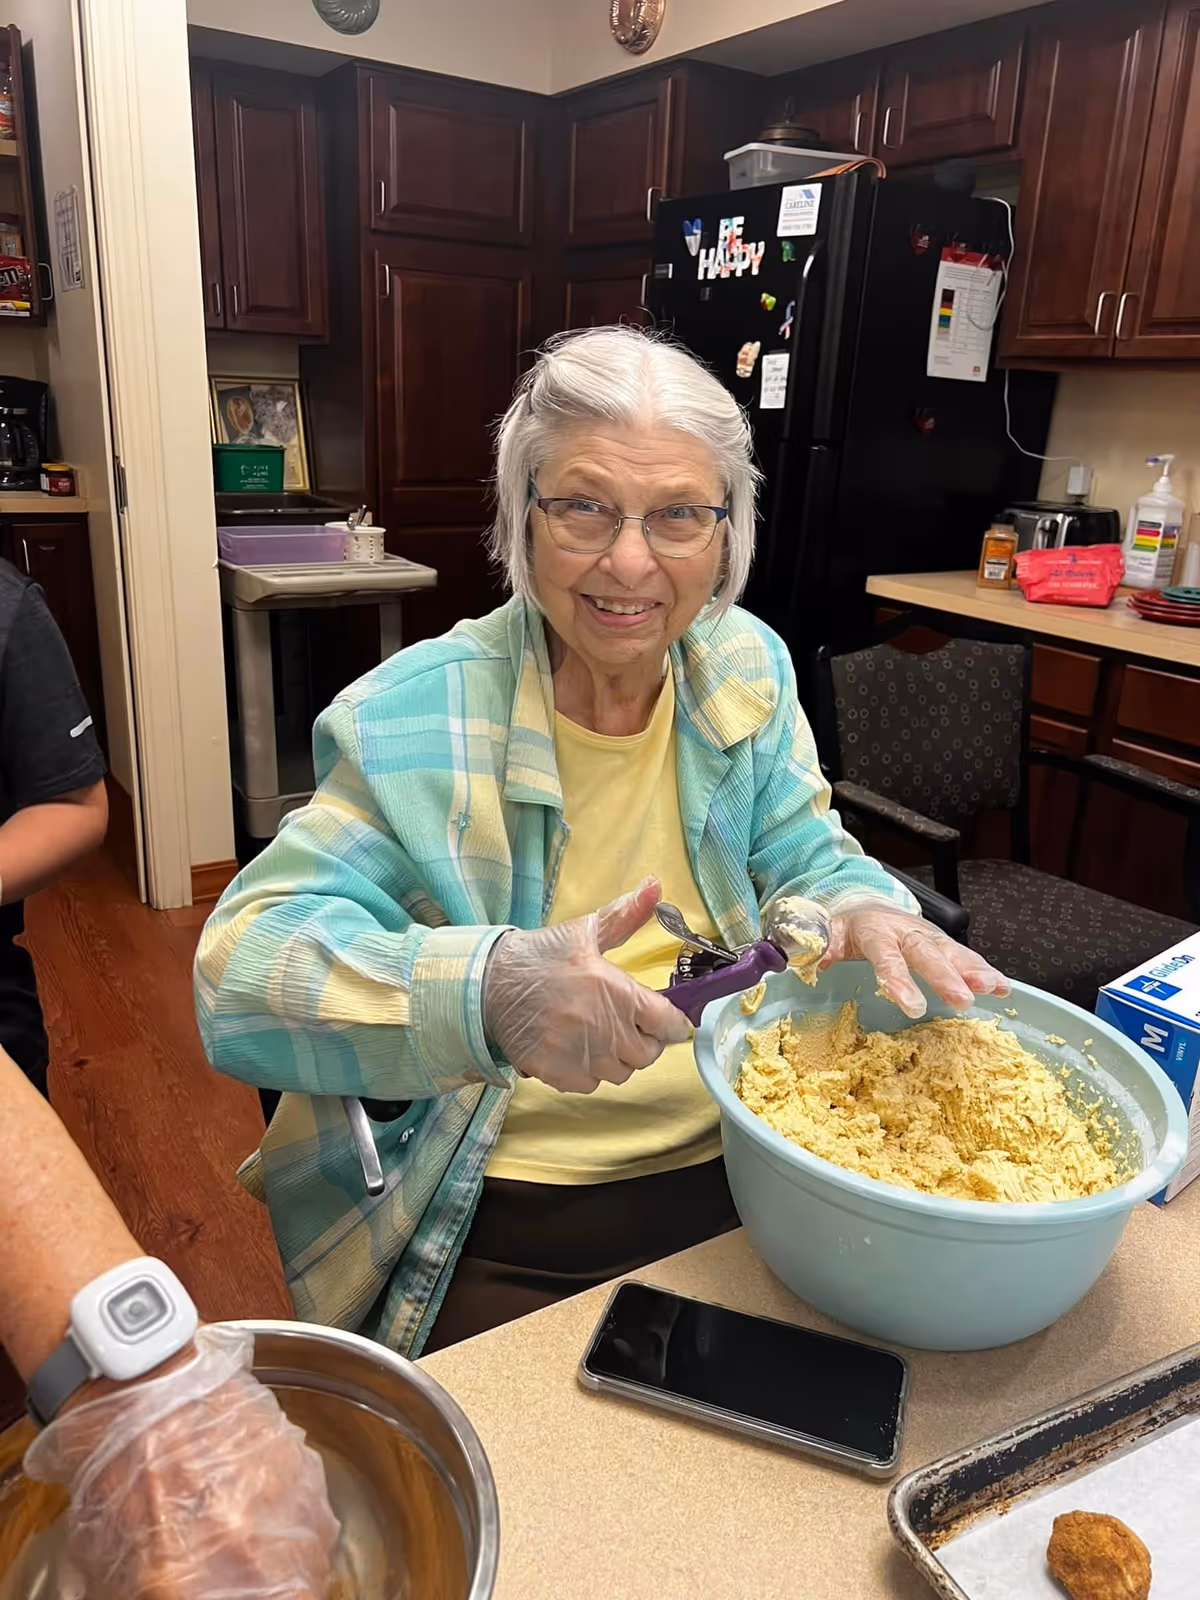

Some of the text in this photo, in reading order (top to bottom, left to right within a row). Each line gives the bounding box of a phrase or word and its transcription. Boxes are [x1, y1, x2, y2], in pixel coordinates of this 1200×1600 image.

[719, 216, 745, 241] BE
[697, 241, 765, 280] HAPPY
[1149, 955, 1196, 977] GlideOn
[1140, 1023, 1168, 1053] M
[1175, 1041, 1186, 1061] VINYL
